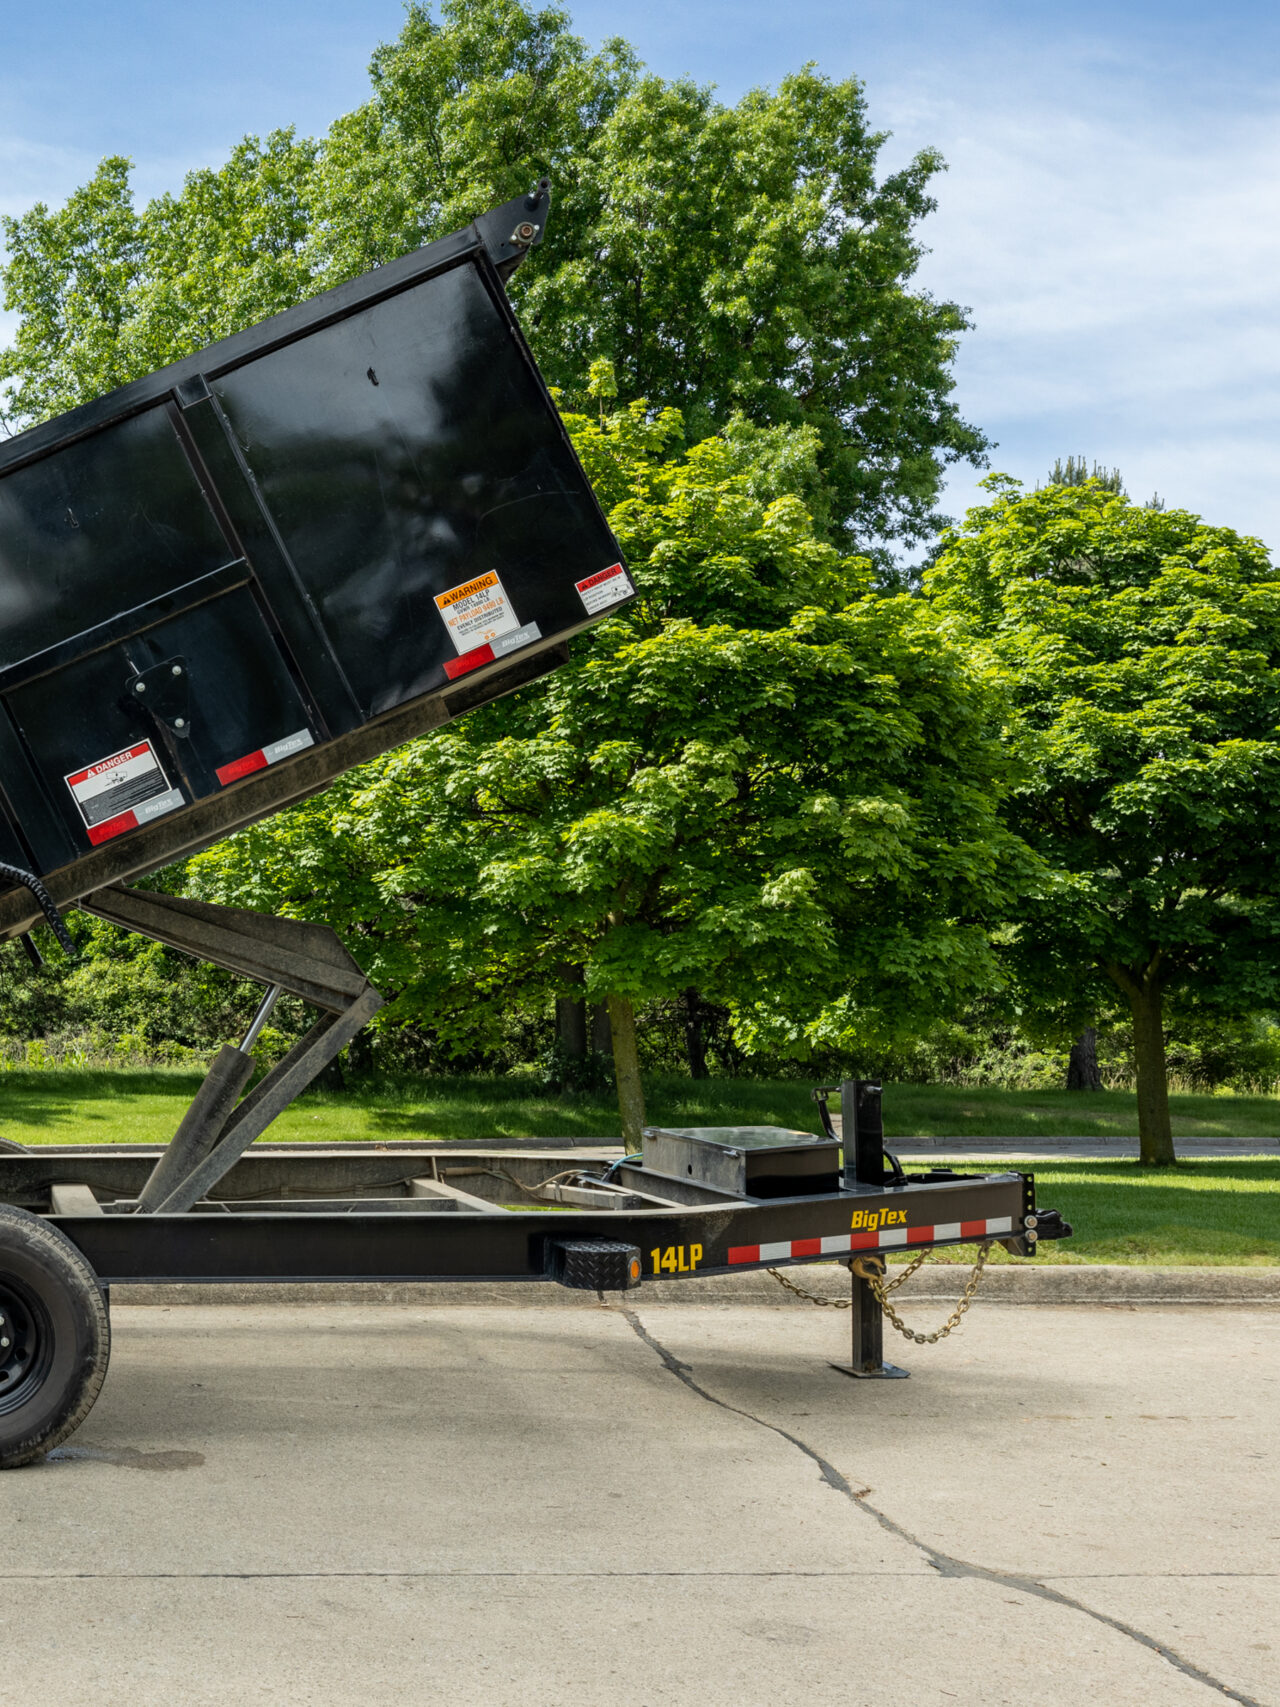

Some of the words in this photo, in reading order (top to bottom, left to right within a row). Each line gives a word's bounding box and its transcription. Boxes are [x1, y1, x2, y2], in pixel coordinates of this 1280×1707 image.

[588, 568, 616, 586] DANGER
[450, 577, 493, 601] WARNING
[452, 597, 474, 610] MODEL
[448, 616, 459, 627] NET
[459, 606, 483, 622] PAYLOAD
[457, 620, 473, 630] EVENLY
[473, 606, 502, 623] DISTRIBUTED
[95, 751, 132, 773] DANGER
[144, 797, 172, 814] BigTex
[851, 1208, 907, 1231] BigTex
[651, 1243, 702, 1274] 14LP
